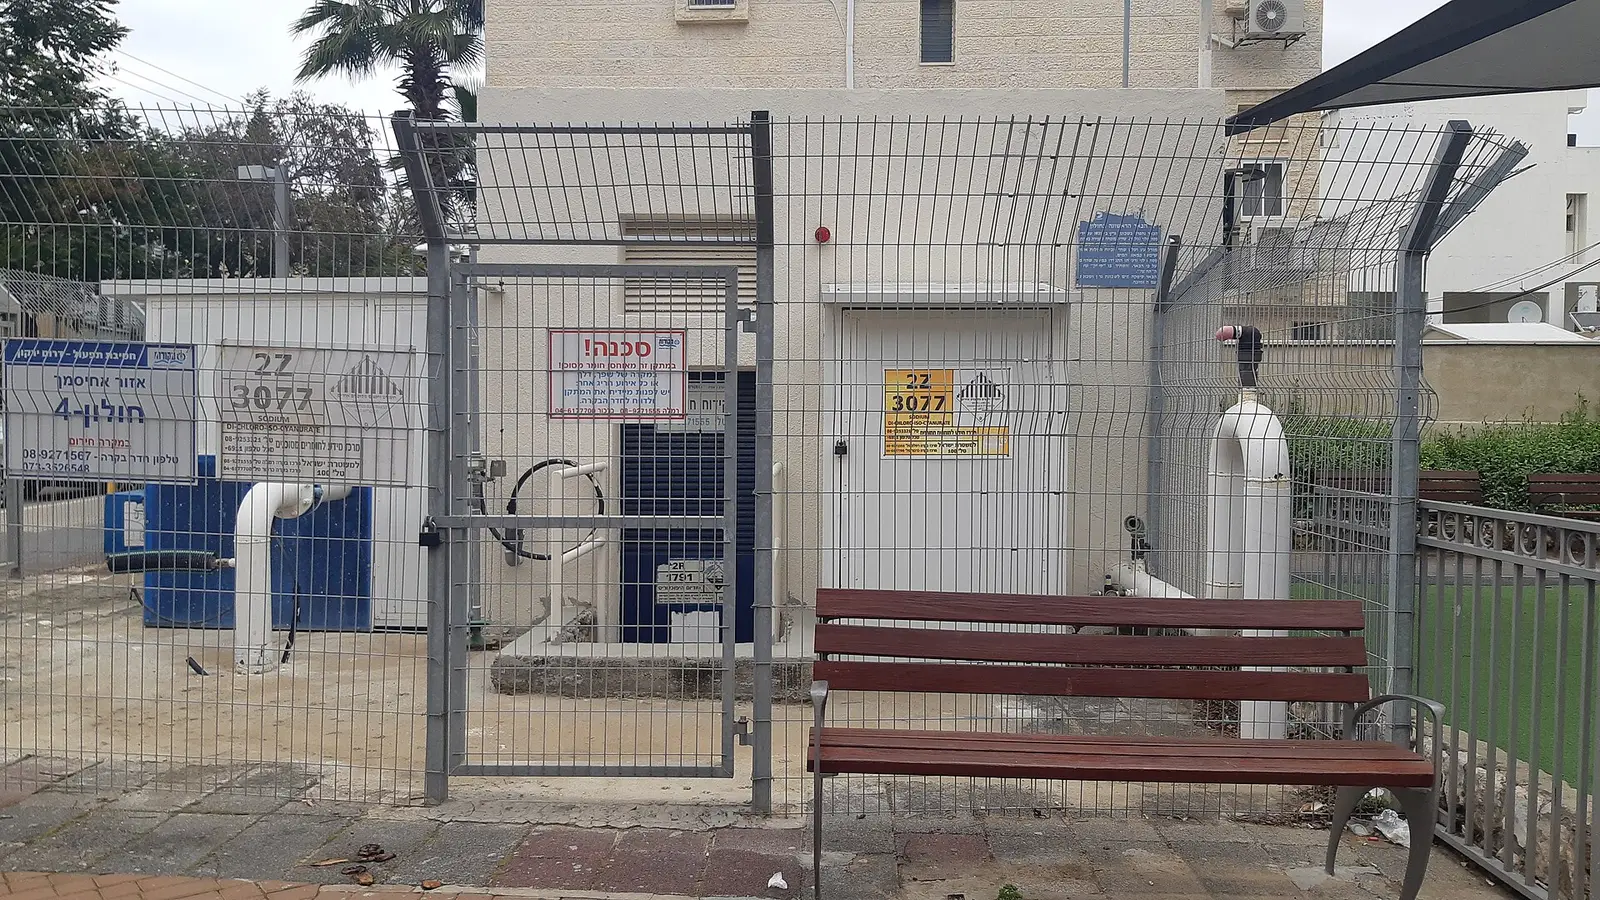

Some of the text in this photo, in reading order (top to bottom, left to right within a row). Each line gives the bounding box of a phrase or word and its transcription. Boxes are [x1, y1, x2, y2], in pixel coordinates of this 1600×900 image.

[584, 339, 651, 357] סכנה!
[255, 353, 292, 377] 2Z
[54, 375, 146, 389] אזור אחיסמך
[906, 374, 932, 389] 2Z
[233, 385, 313, 410] 3077
[892, 395, 946, 411] 3077
[227, 424, 321, 433] DI-CHLORO-SO-CYANURATE
[23, 449, 91, 460] 08-9271567
